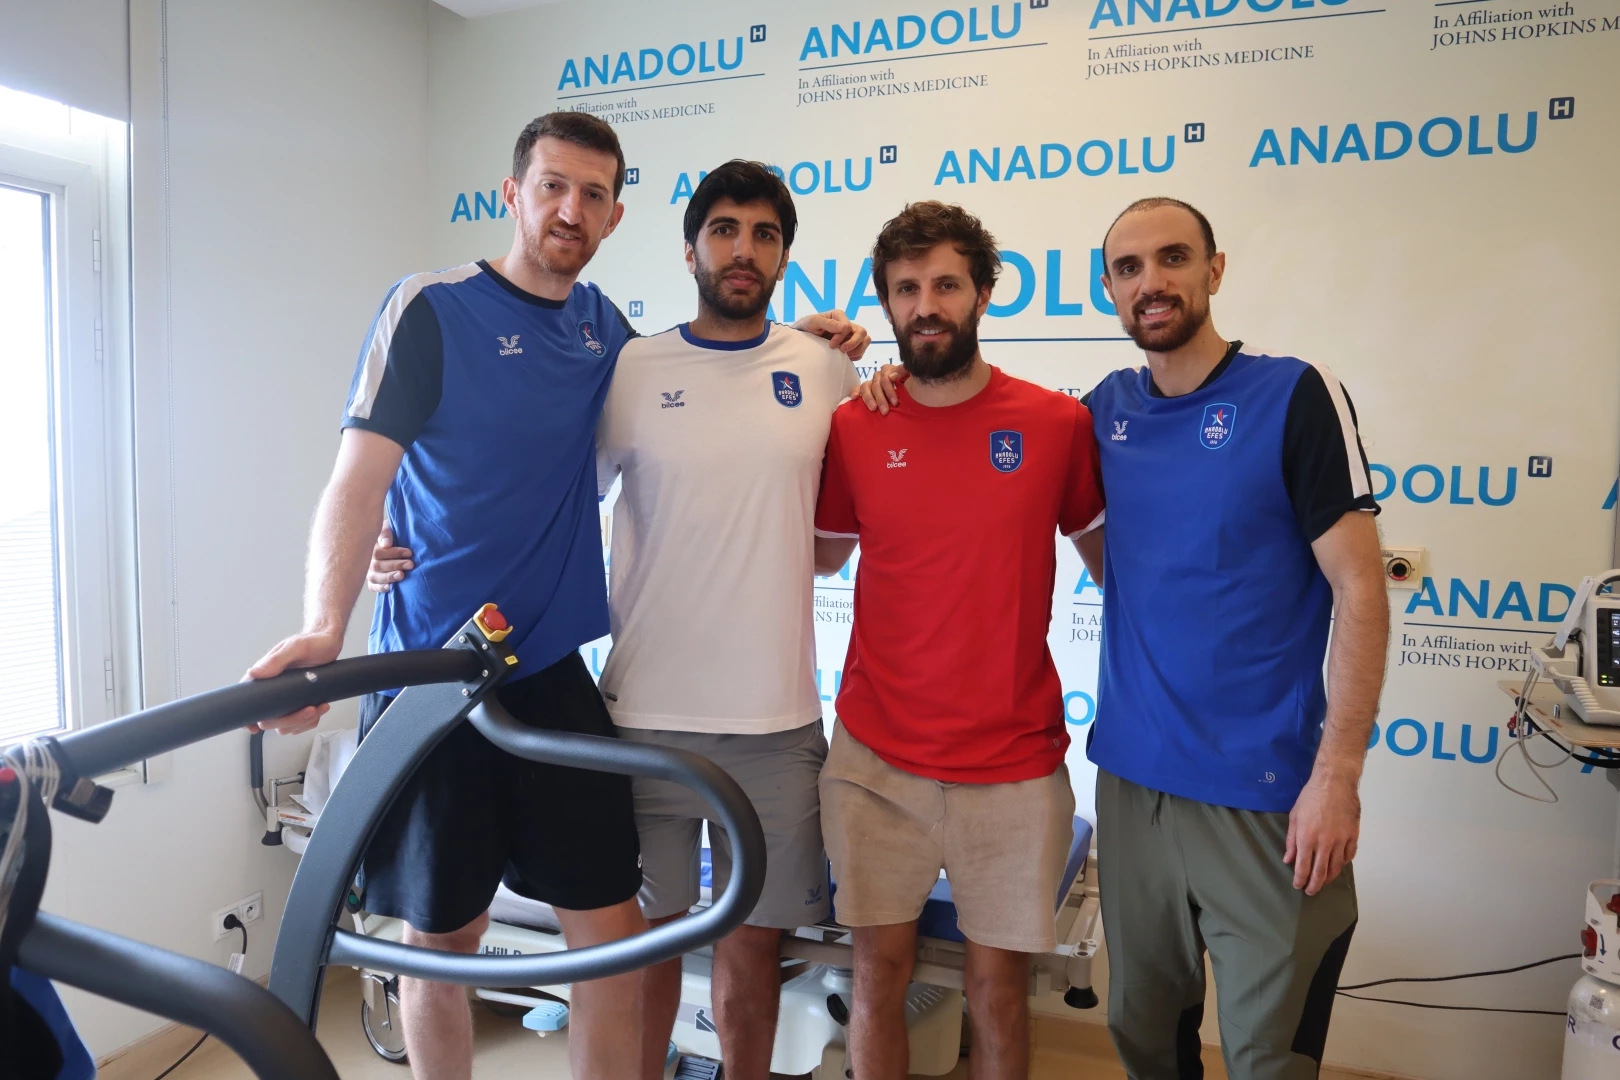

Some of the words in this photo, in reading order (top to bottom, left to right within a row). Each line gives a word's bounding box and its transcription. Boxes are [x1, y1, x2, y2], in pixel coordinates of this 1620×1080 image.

[1433, 15, 1449, 29] In
[1453, 9, 1533, 27] Affiliation
[1538, 1, 1575, 18] with
[799, 2, 1022, 61] ANADOLU
[1430, 28, 1497, 51] JOHNS
[1501, 18, 1597, 41] HOPKINS
[557, 36, 743, 91] ANADOLU
[1085, 60, 1140, 80] JOHNS
[1143, 52, 1220, 72] HOPKINS
[1224, 45, 1315, 65] MEDICINE
[1087, 48, 1100, 61] In
[1104, 43, 1169, 60] Affiliation
[1172, 38, 1202, 53] with
[796, 89, 843, 107] JOHNS
[845, 82, 910, 100] HOPKINS
[913, 74, 989, 93] MEDICINE
[798, 78, 809, 90] In
[812, 73, 867, 88] Affiliation
[869, 68, 895, 83] with
[570, 102, 614, 113] Affiliation
[616, 97, 637, 109] with
[652, 102, 716, 120] MEDICINE
[1249, 111, 1538, 168] ANADOLU
[934, 135, 1175, 186] ANADOLU
[1405, 576, 1577, 623] ANAD
[1072, 612, 1084, 625] In
[1069, 628, 1101, 643] JOH
[1402, 633, 1416, 647] In
[1420, 635, 1495, 652] Affiliation
[1499, 641, 1532, 655] with
[1398, 651, 1461, 667] JOHNS
[1465, 655, 1531, 673] HOPKI
